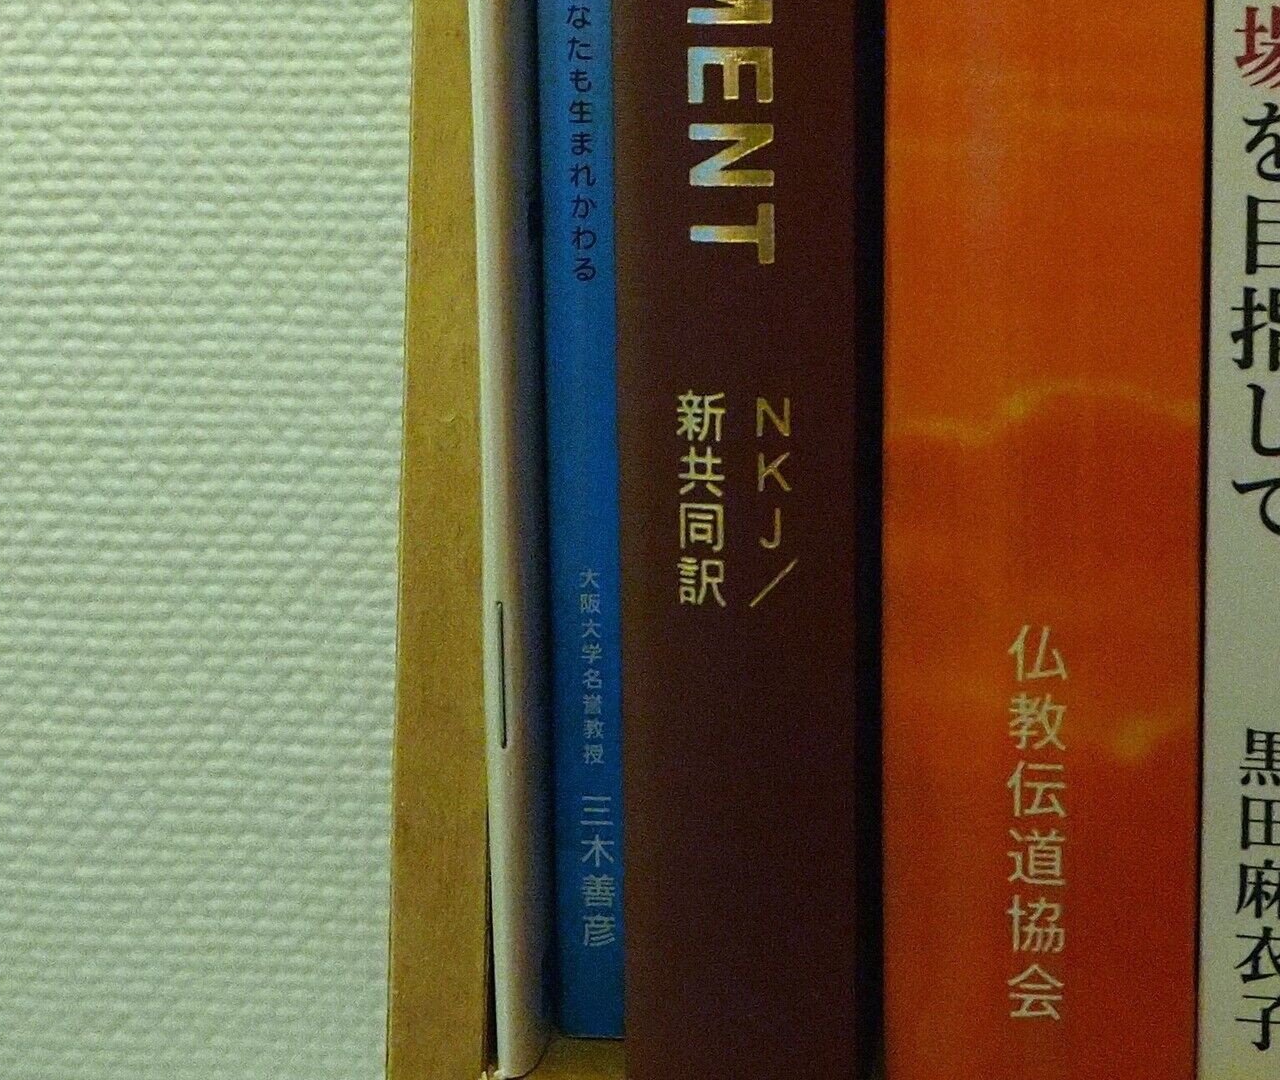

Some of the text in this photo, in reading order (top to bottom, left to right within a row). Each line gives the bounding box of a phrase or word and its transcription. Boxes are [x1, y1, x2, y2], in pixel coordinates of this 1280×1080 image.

[676, 388, 727, 608] 新共同訳
[580, 793, 616, 948] 三木善彦
[1006, 624, 1068, 1021] 仏教伝道協会
